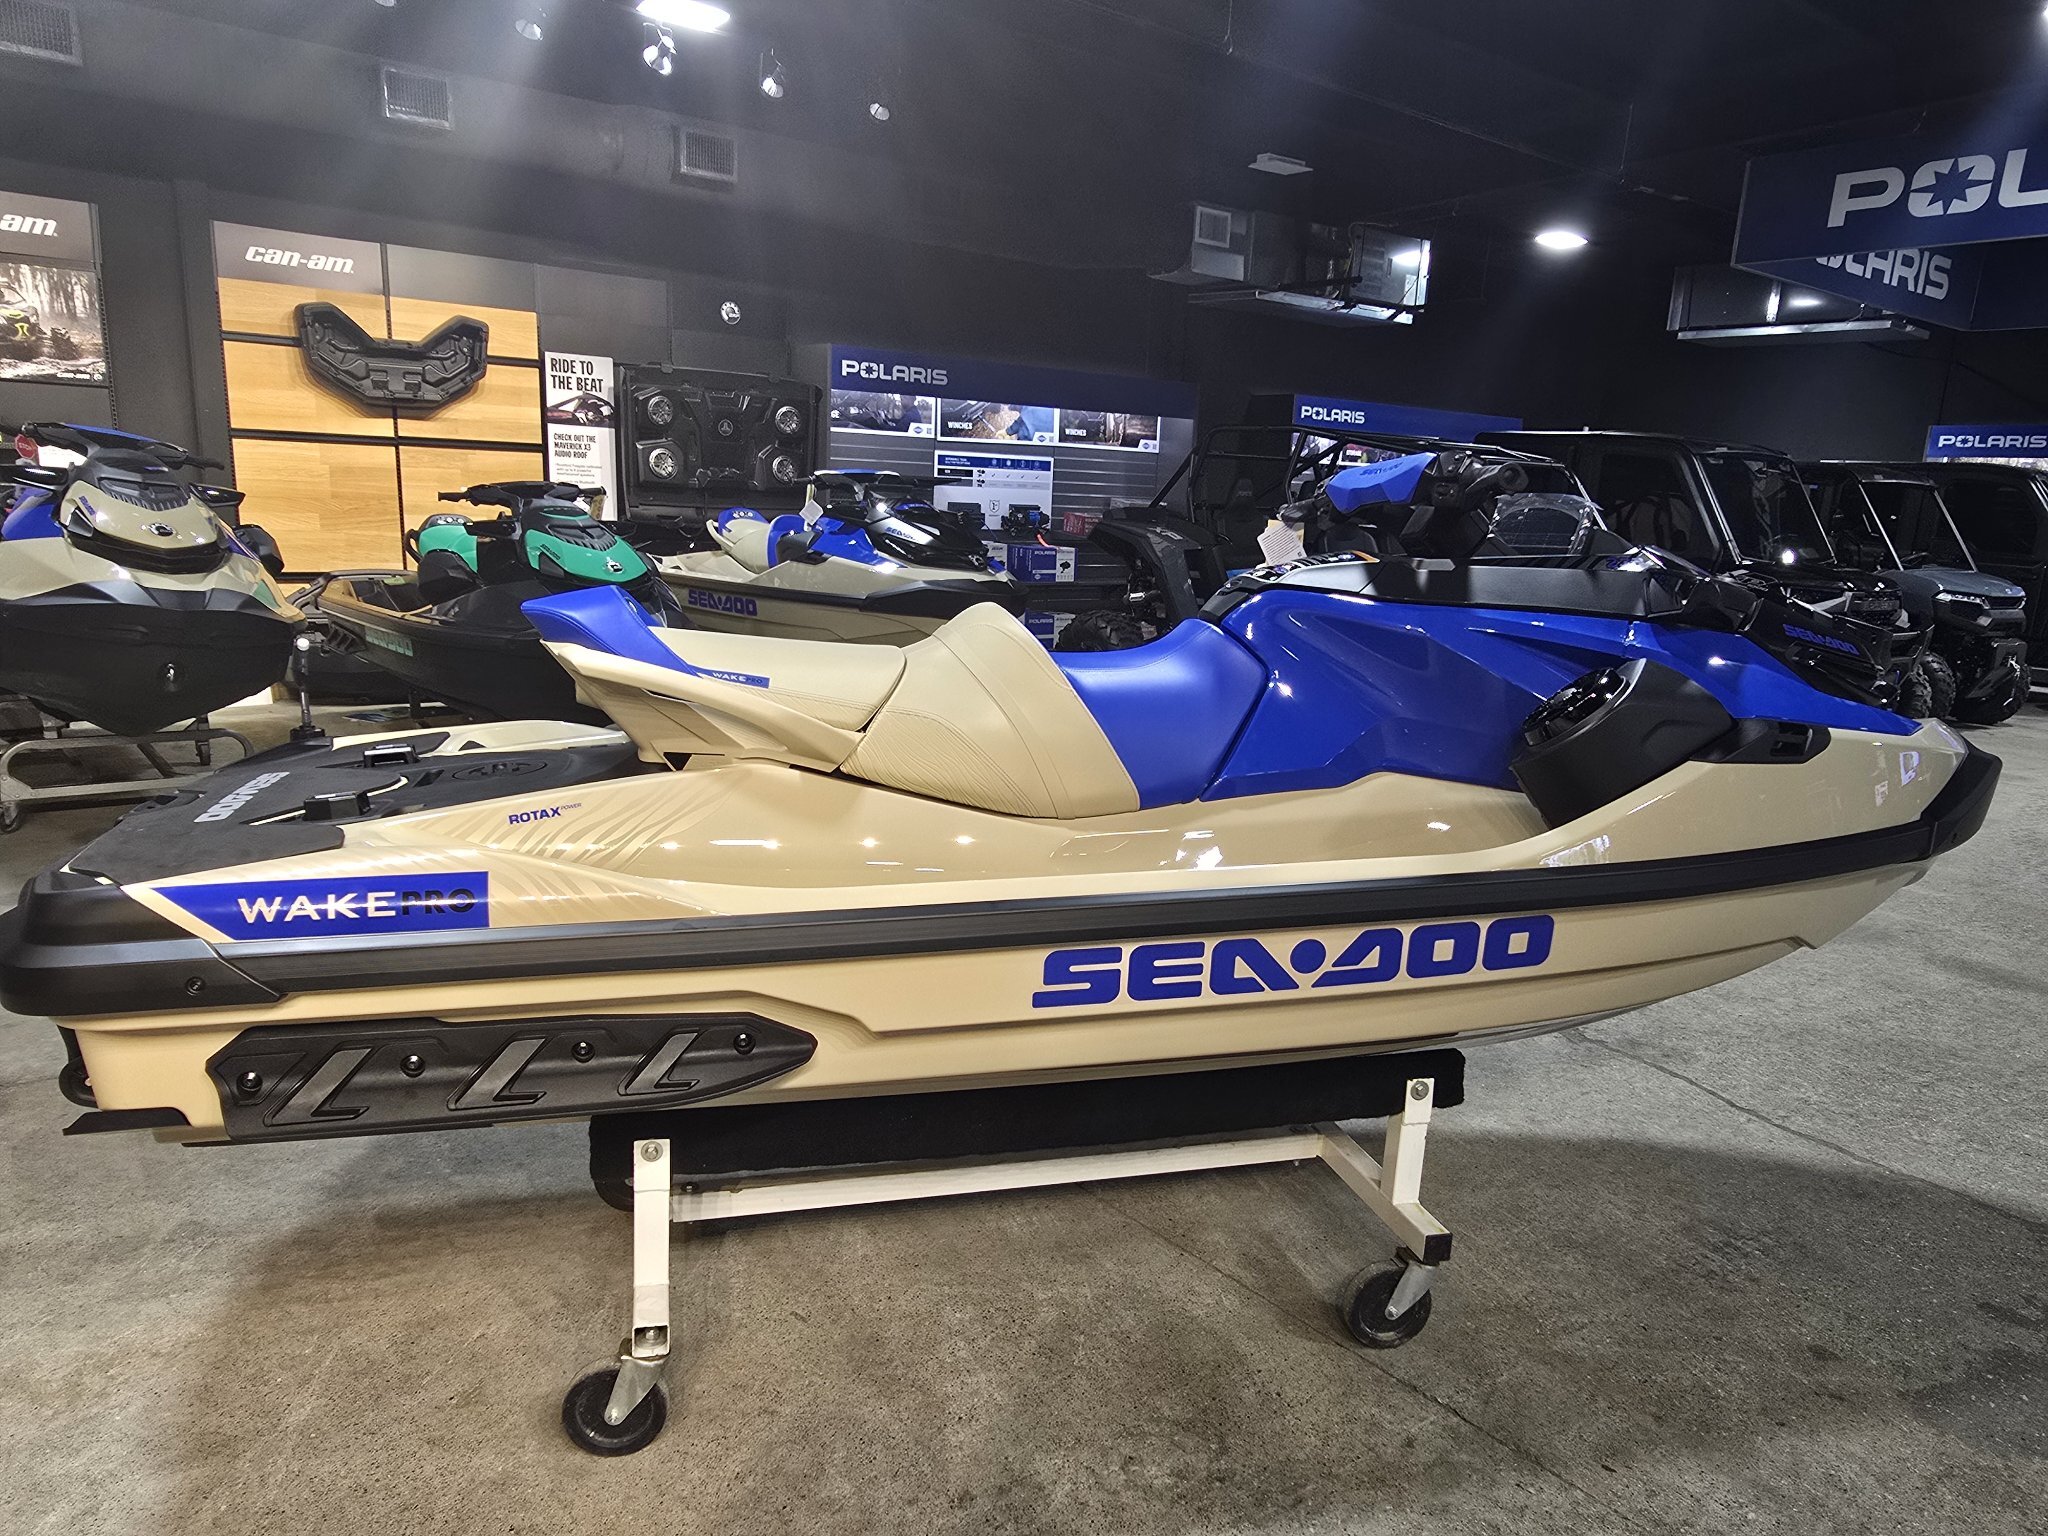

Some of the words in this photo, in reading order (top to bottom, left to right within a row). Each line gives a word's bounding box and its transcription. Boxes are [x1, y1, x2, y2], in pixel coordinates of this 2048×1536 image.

[245, 246, 354, 274] can-am
[1816, 247, 1953, 300] LARIS
[550, 357, 577, 374] RIDE
[579, 360, 594, 376] TO
[841, 359, 949, 386] POLARIS
[550, 374, 573, 391] THE
[576, 376, 604, 393] BEAT
[1300, 405, 1366, 425] POLARIS
[947, 421, 973, 430] WINCHES
[1065, 428, 1088, 437] WINCHES
[553, 432, 573, 442] CHECK
[573, 434, 585, 442] OUT
[586, 435, 597, 443] THE
[554, 441, 583, 451] MAVERICK
[1937, 435, 2048, 449] POLARIS
[554, 449, 572, 458] AUDIO
[573, 451, 588, 459] ROOF
[508, 806, 562, 825] ROTAX
